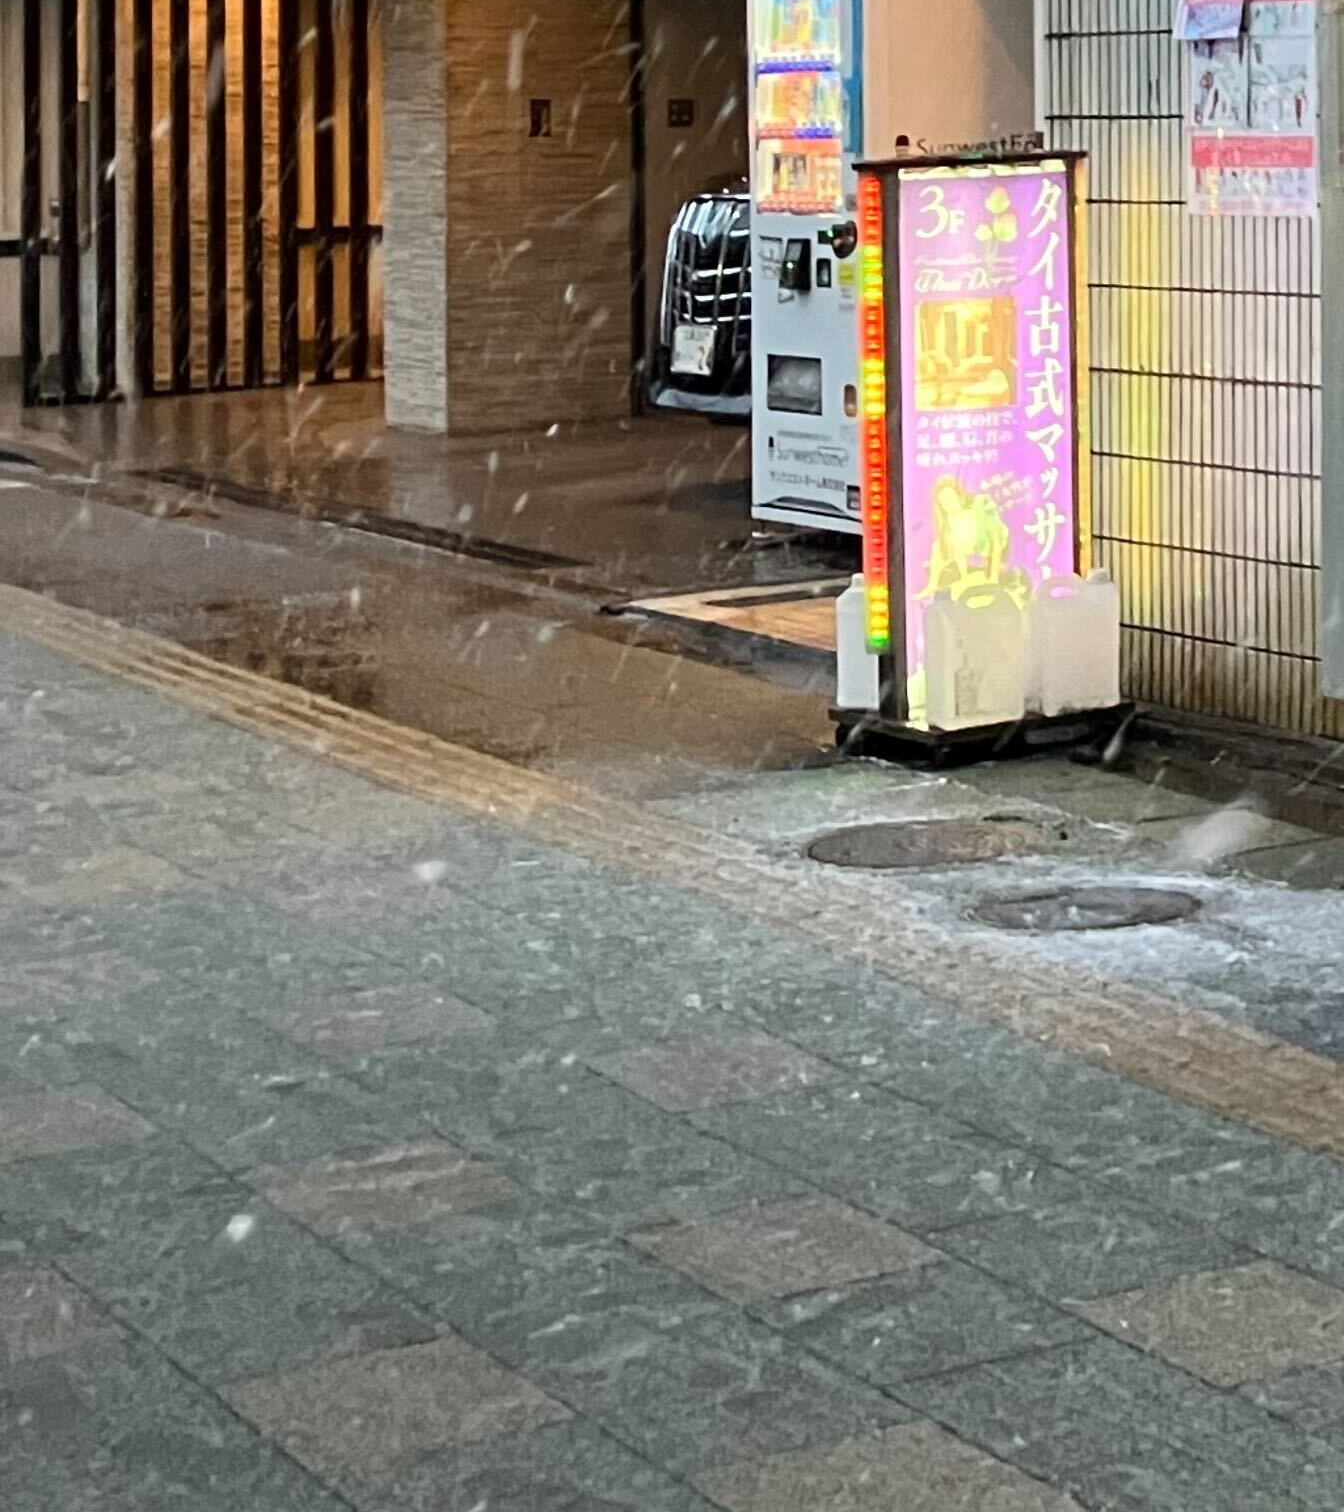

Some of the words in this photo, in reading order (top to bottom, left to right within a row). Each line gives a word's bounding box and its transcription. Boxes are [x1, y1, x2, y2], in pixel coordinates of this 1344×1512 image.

[915, 185, 965, 238] 3F
[1023, 178, 1067, 580] タイ古式マッサ
